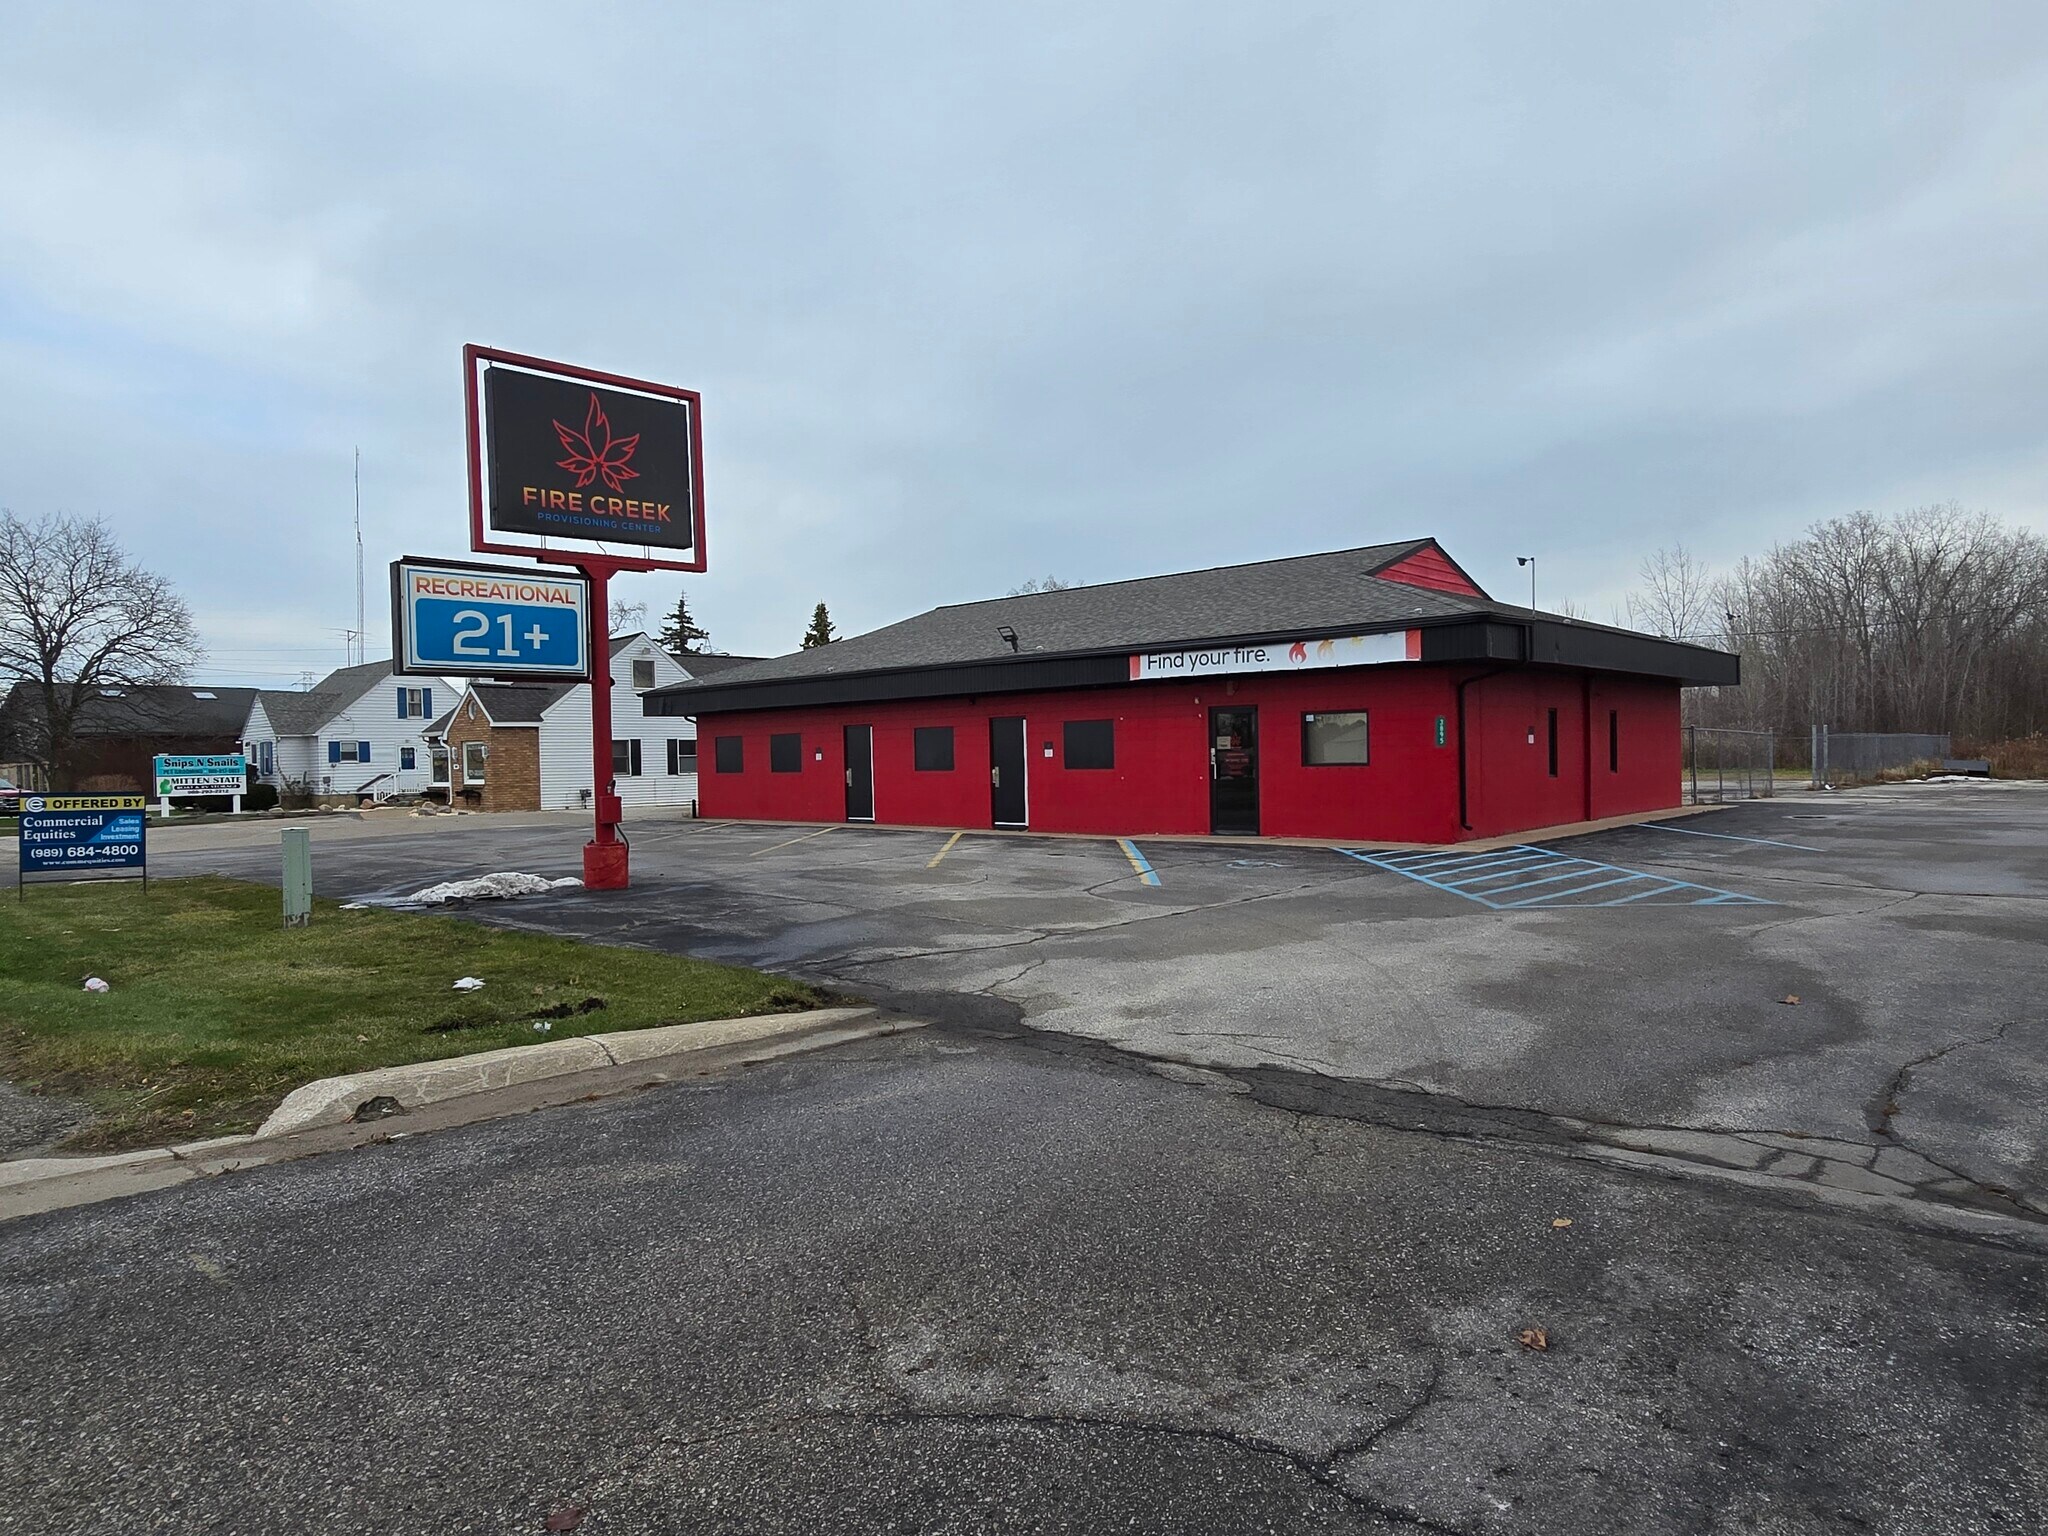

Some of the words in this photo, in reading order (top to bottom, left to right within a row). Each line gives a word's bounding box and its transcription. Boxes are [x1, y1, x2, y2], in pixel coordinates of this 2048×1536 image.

[523, 486, 583, 512] FIRE
[590, 495, 672, 523] CREEK
[537, 511, 618, 529] PROVISIONING
[621, 521, 662, 534] CENTER
[415, 576, 577, 605] RECREATIONAL
[452, 609, 550, 657] 21+
[1147, 651, 1184, 670] Find
[1188, 650, 1230, 672] your
[1233, 647, 1270, 664] fire.
[164, 758, 194, 769] Snips
[196, 758, 204, 767] N
[207, 757, 239, 767] Snails
[213, 776, 242, 784] STATE
[52, 799, 118, 809] OFFERED
[123, 798, 142, 808] BY
[23, 815, 103, 828] Commercial
[23, 829, 76, 842] Equities
[111, 825, 140, 834] Leasing
[100, 833, 140, 841] Investment
[31, 847, 63, 859] (989)
[67, 845, 139, 857] 684-4800
